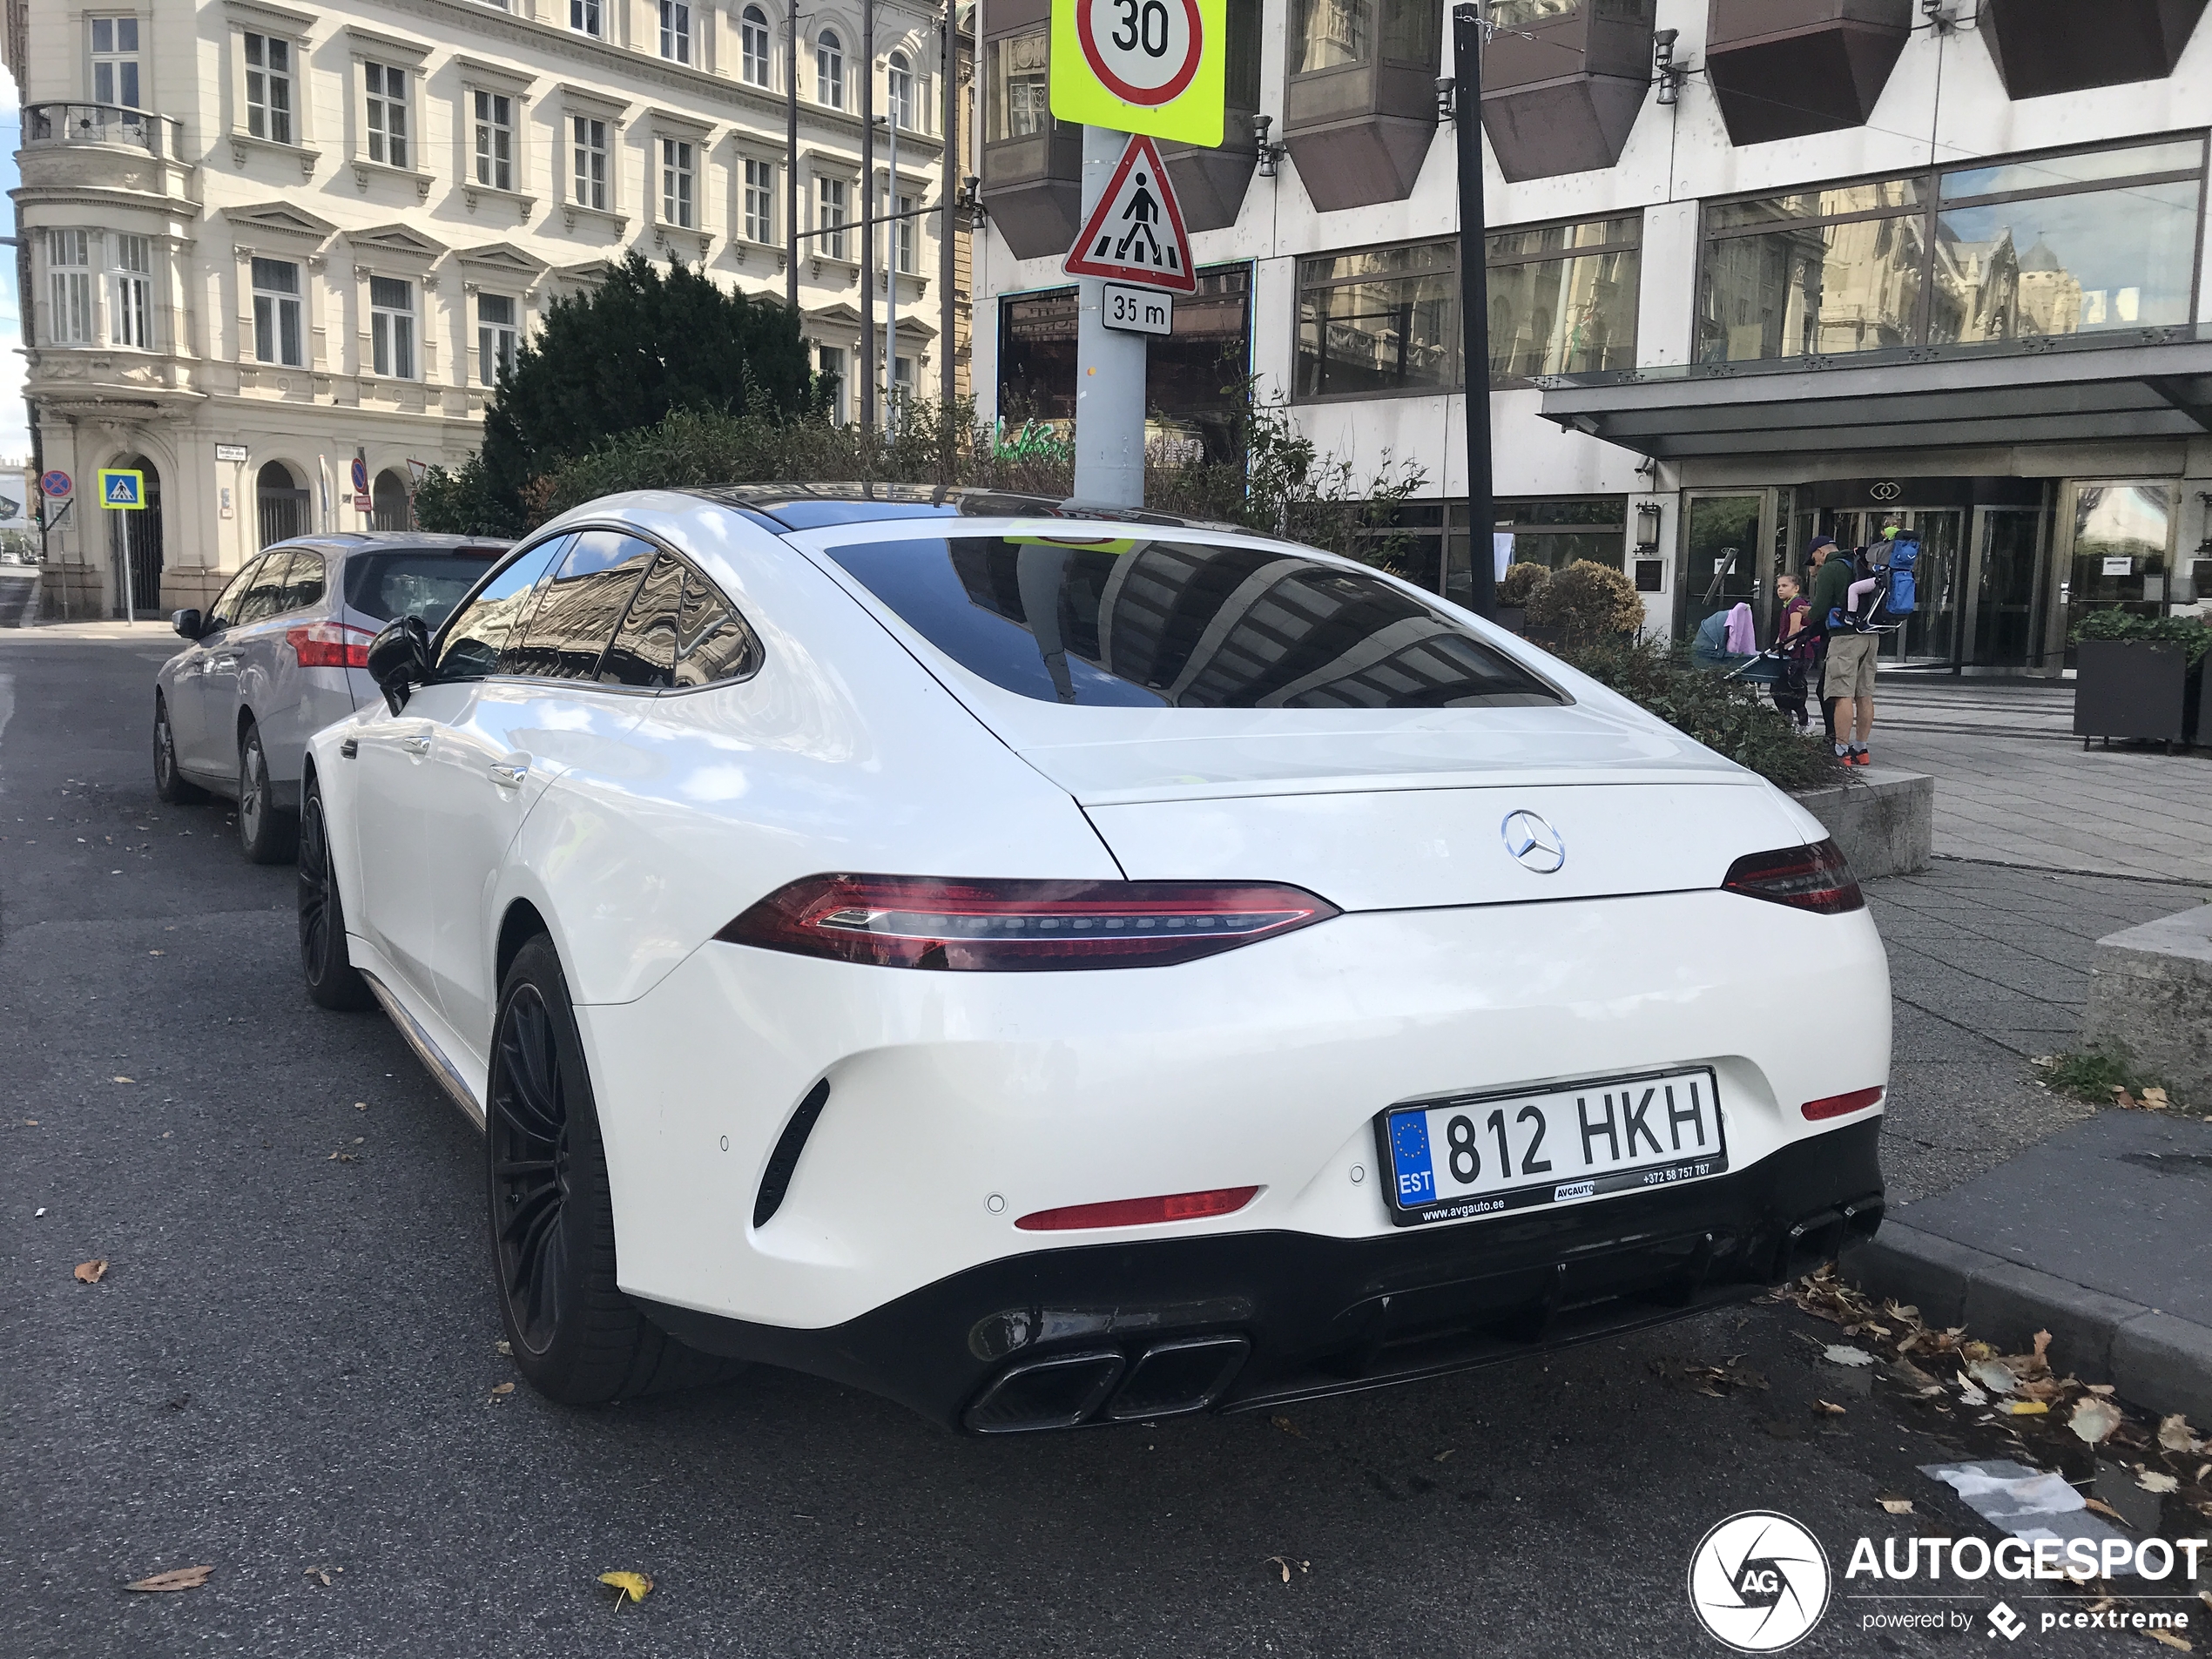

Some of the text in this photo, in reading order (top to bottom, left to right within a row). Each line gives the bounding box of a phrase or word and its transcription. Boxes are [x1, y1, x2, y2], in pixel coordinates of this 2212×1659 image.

[1112, 0, 1168, 57] 30
[1114, 295, 1164, 325] 35 m
[1447, 1082, 1705, 1184] 812 HKH
[1399, 1170, 1432, 1194] EST
[1643, 1163, 1710, 1184] +372 58 757 787
[1422, 1199, 1505, 1221] www.avgauto.ee
